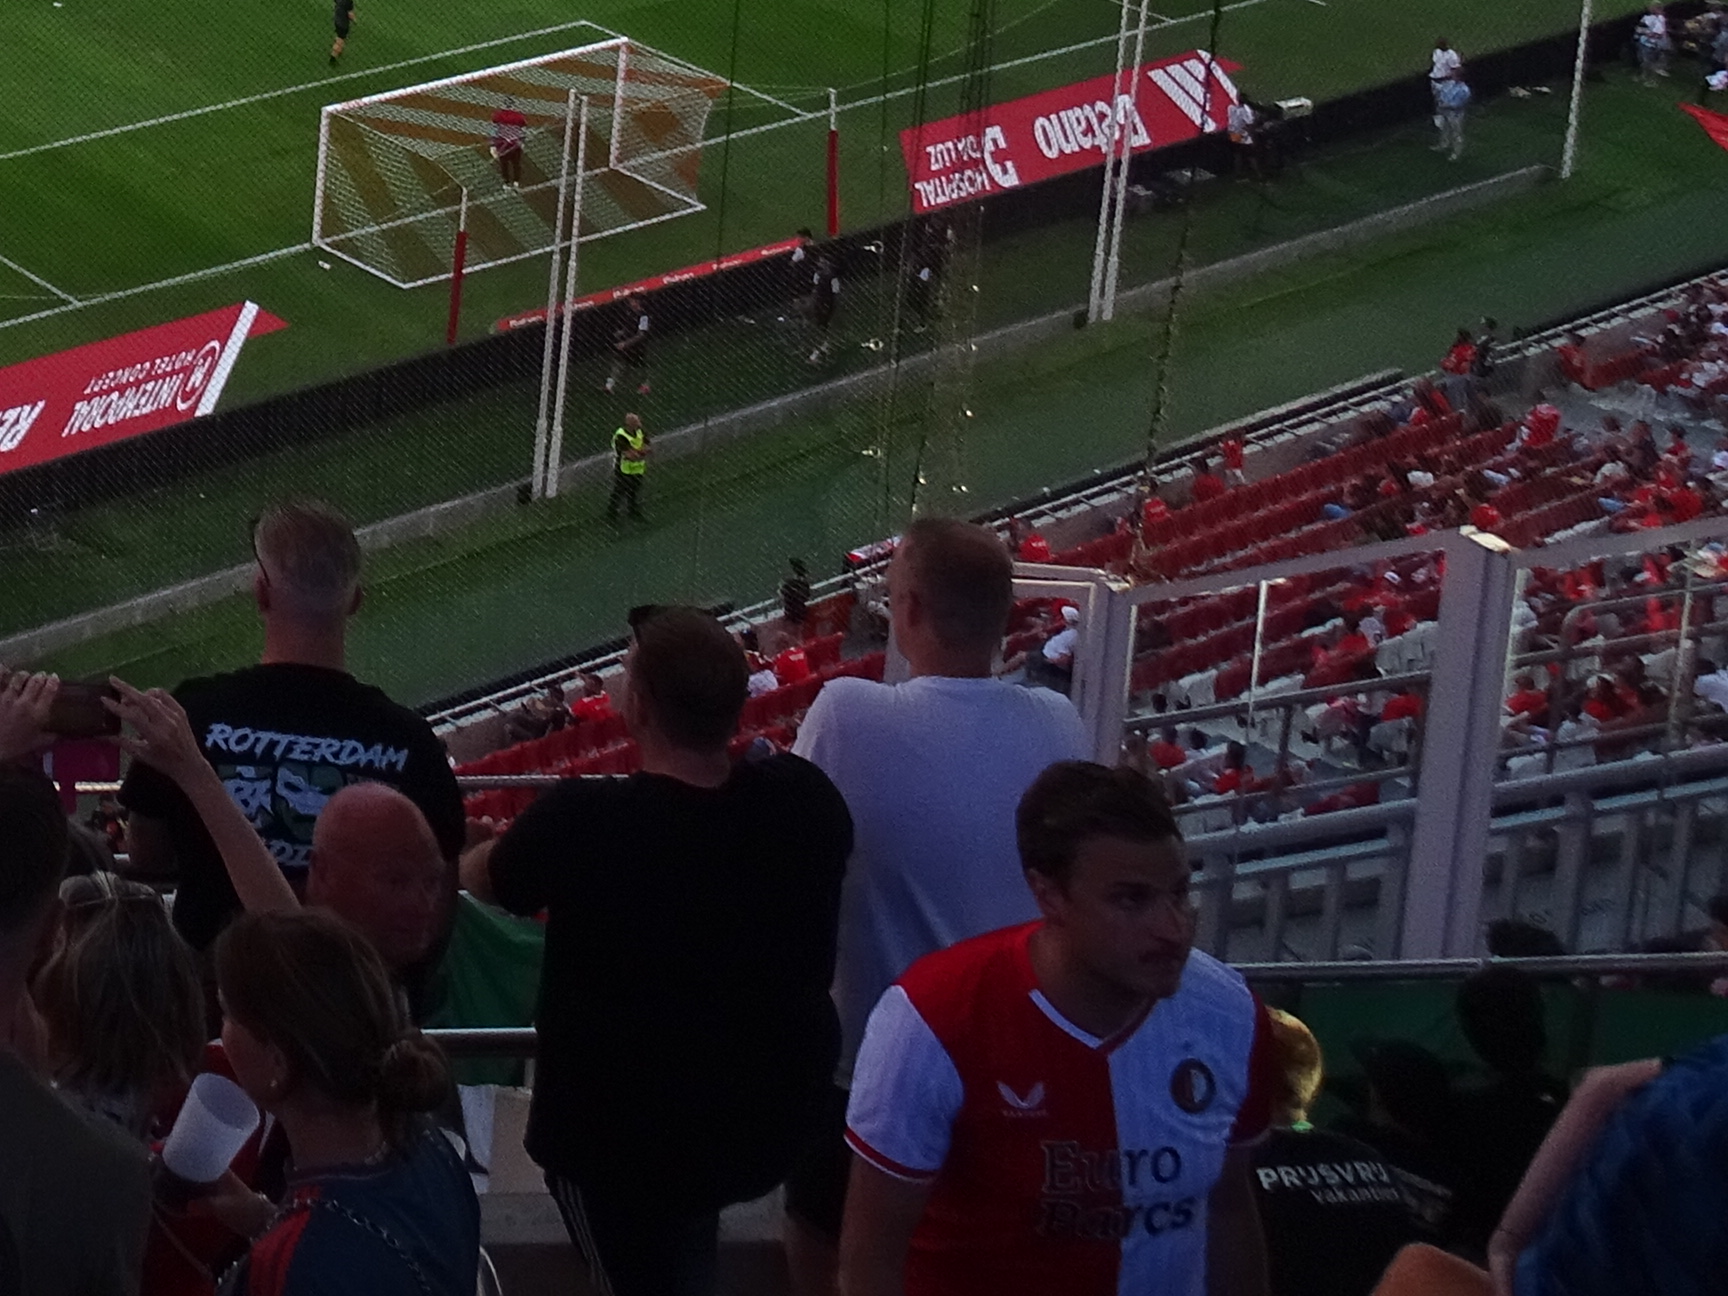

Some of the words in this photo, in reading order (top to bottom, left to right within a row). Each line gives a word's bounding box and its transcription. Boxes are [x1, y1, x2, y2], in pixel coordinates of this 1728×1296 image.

[1033, 93, 1152, 160] Betano
[924, 138, 957, 171] LUZ
[913, 164, 991, 208] HOSPITAL
[62, 371, 180, 438] INTEMPORAL
[204, 721, 409, 774] ROTTERDAM
[1039, 1139, 1182, 1196] Euro
